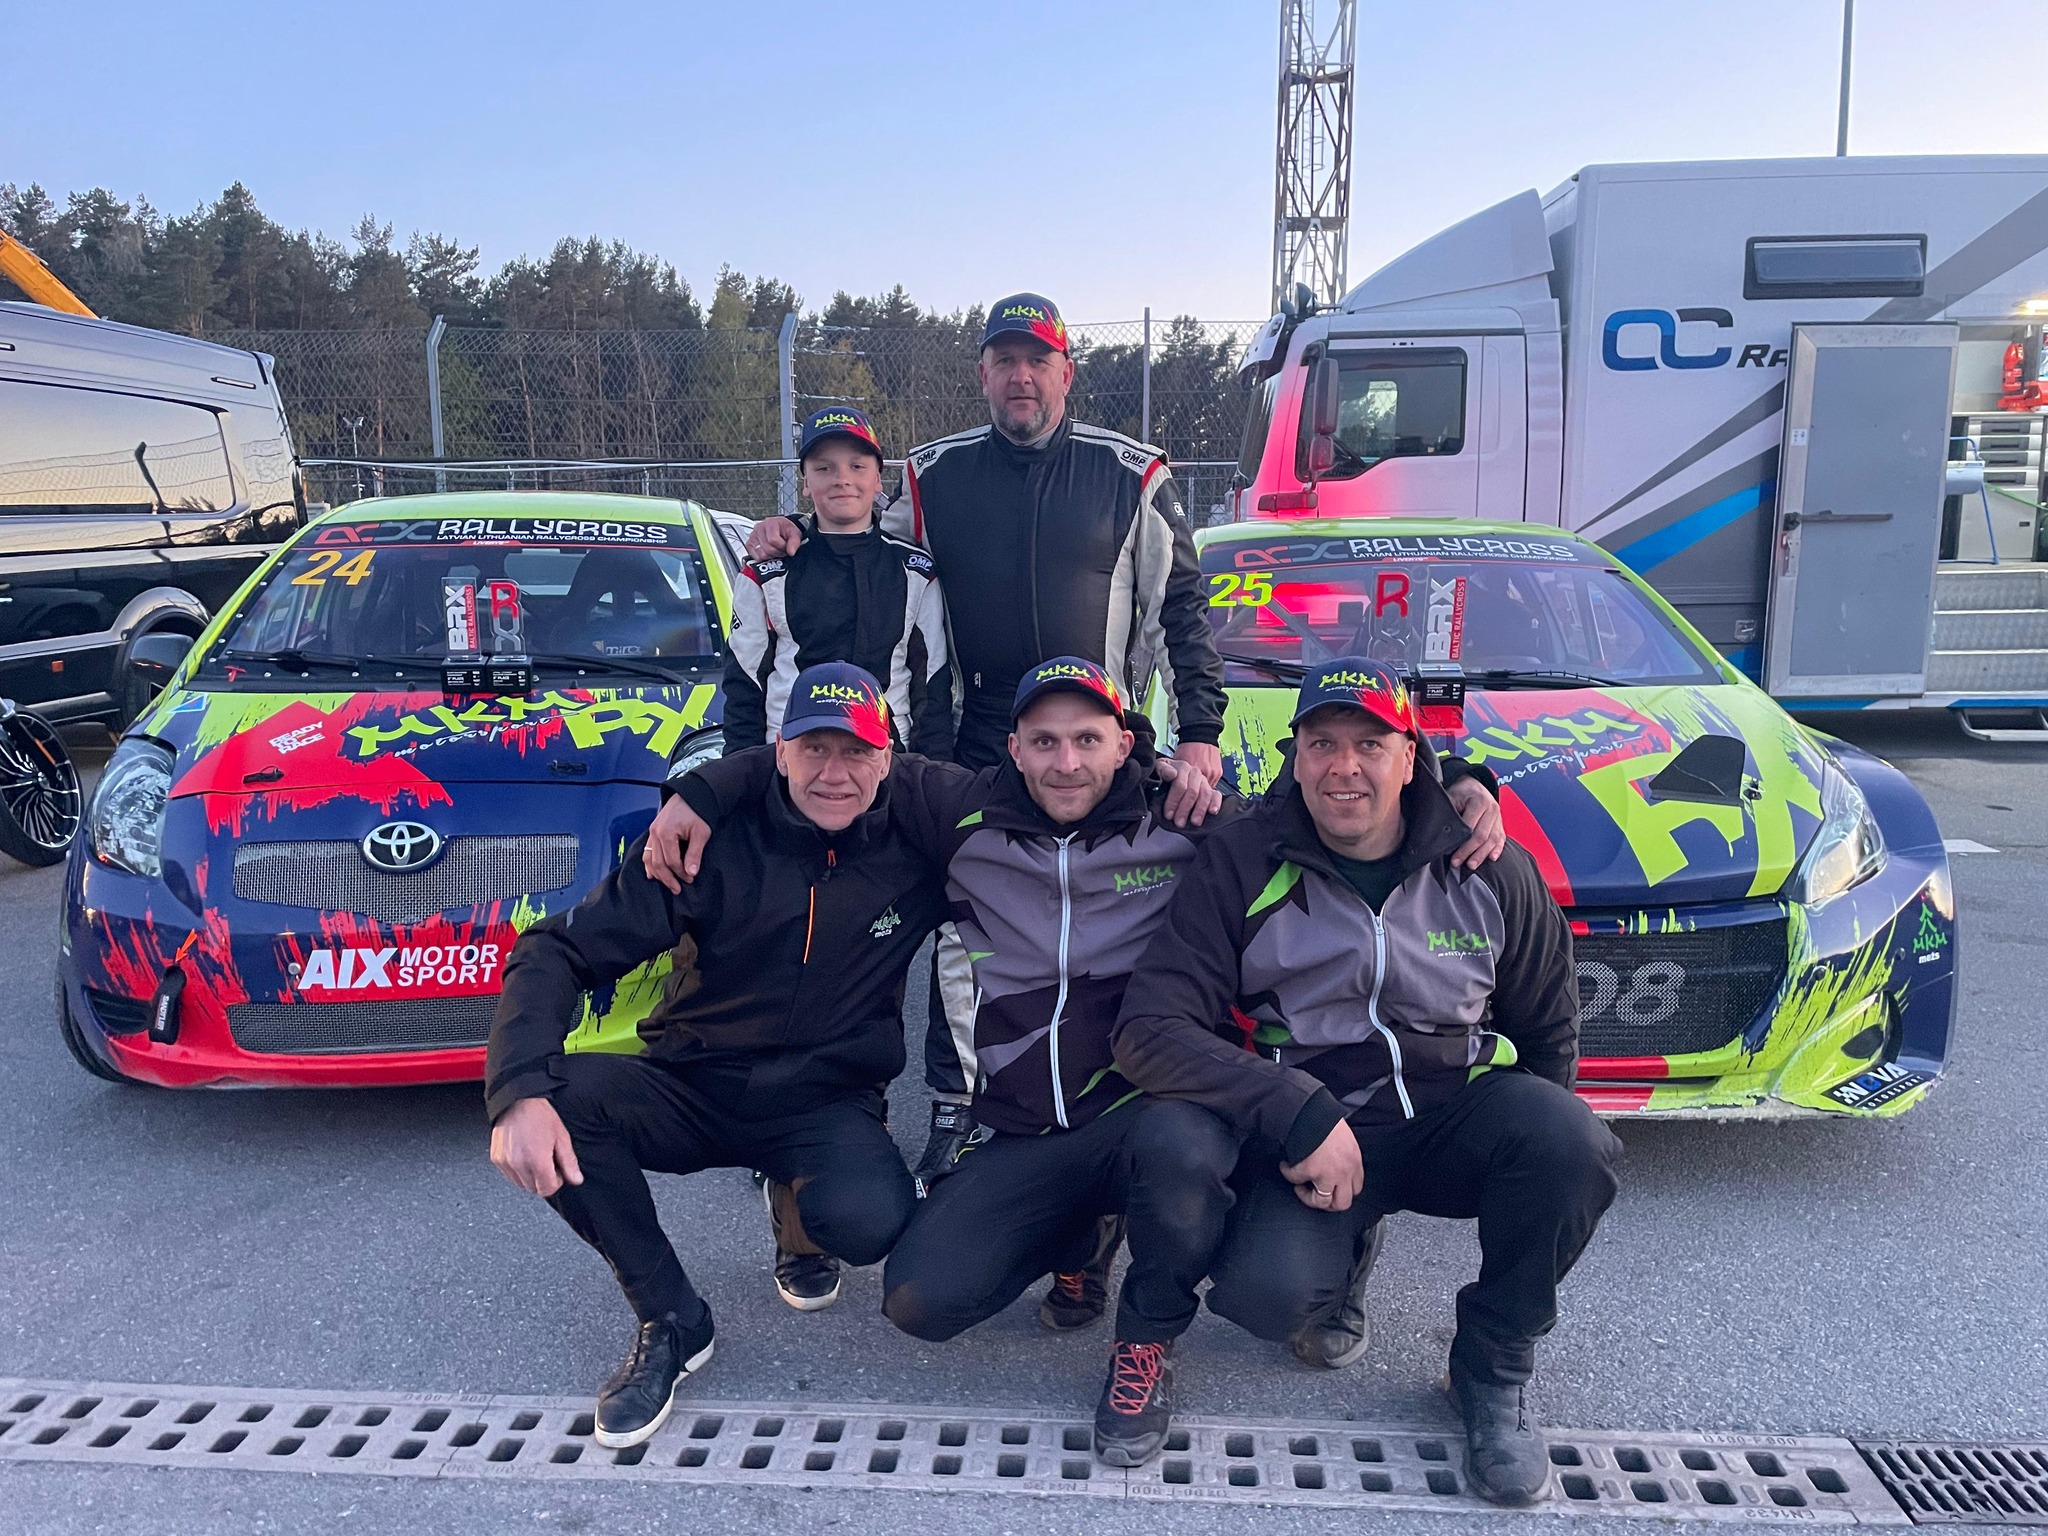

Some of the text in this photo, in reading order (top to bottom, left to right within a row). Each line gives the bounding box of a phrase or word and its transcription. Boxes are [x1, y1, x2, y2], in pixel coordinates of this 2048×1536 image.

[917, 450, 937, 466] OMP
[1122, 451, 1146, 464] OMP
[439, 518, 668, 540] RALLYCROSS
[597, 536, 668, 544] CHAMPIONSHIP
[1348, 537, 1574, 558] RALLYCROSS
[290, 550, 376, 586] 24
[758, 560, 784, 573] OMP
[908, 556, 933, 568] OMP
[1209, 573, 1273, 607] 25
[445, 586, 469, 650] BRX
[1425, 578, 1457, 660] BRX
[1451, 580, 1466, 659] BALTIC RALLYCROSS
[1318, 670, 1379, 689] MKM
[809, 683, 865, 702] MKM
[268, 721, 323, 747] READY
[347, 691, 587, 756] MKM
[278, 733, 326, 755] RACE
[1114, 864, 1176, 892] MKM
[1913, 932, 1948, 953] MKM
[400, 944, 499, 966] MOTOR
[298, 948, 398, 989] AIX
[397, 963, 497, 987] SPORT
[1833, 1062, 1909, 1104] NOVA
[935, 1118, 955, 1126] OMP
